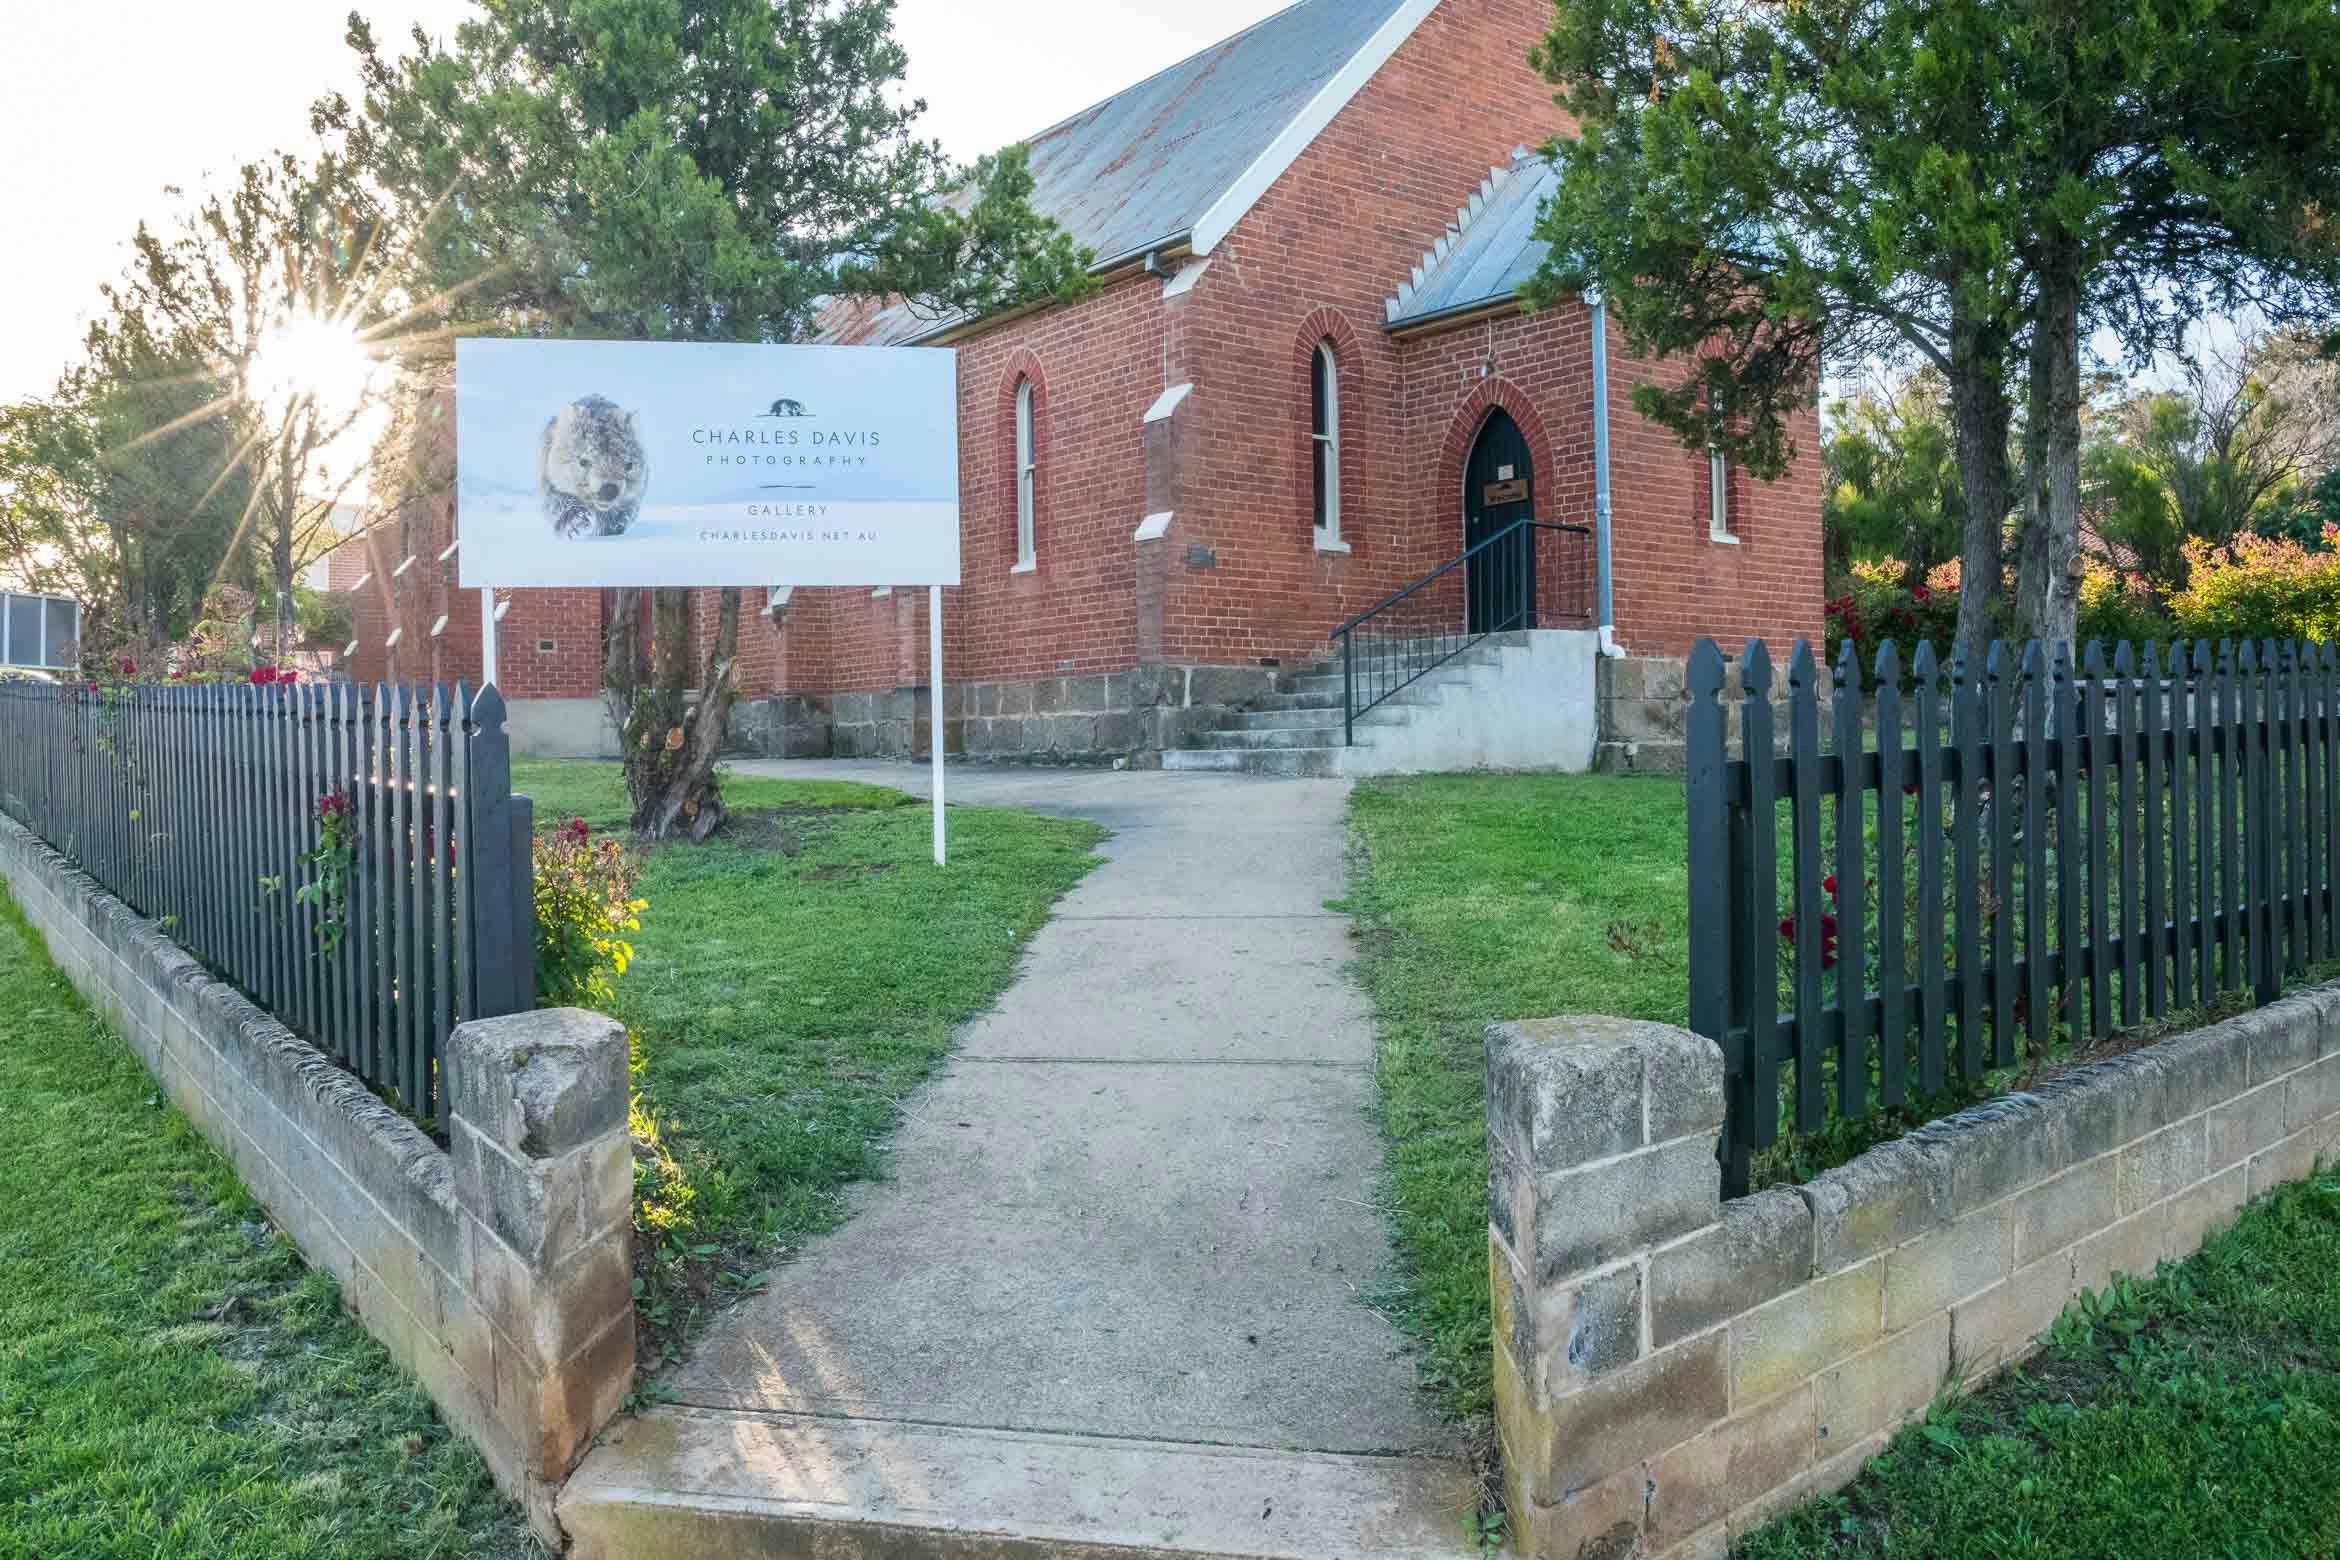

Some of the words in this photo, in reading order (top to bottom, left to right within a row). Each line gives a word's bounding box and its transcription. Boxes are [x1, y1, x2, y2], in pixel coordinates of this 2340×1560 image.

[692, 429, 800, 446] CHARLES
[812, 431, 881, 447] DAVIS
[706, 455, 866, 466] PHOTOGRAPHY
[747, 504, 828, 516] GALLERY
